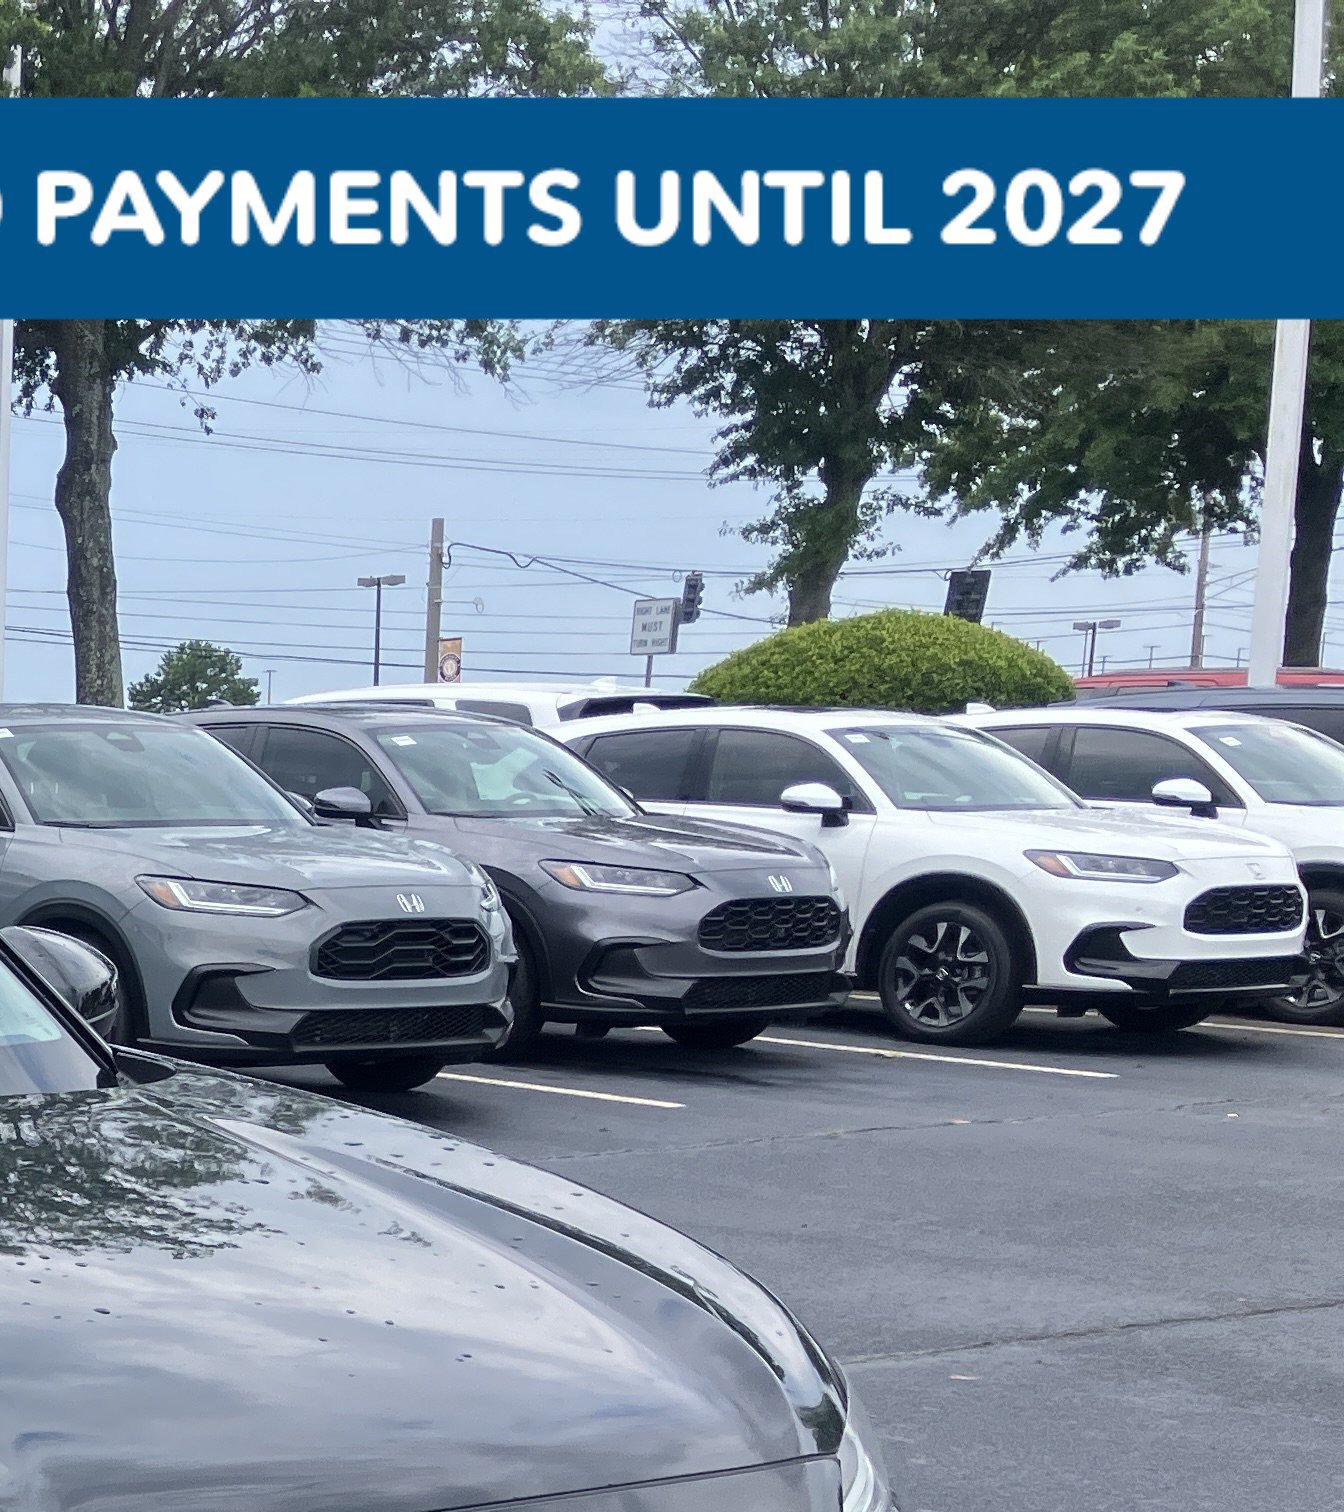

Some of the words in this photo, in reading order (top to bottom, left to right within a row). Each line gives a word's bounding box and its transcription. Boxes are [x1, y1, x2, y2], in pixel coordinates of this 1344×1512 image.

[636, 605, 653, 616] RIGHT
[656, 604, 671, 615] LANE
[641, 621, 663, 632] MUST
[633, 638, 648, 648] TURN
[651, 637, 669, 648] RIGHT
